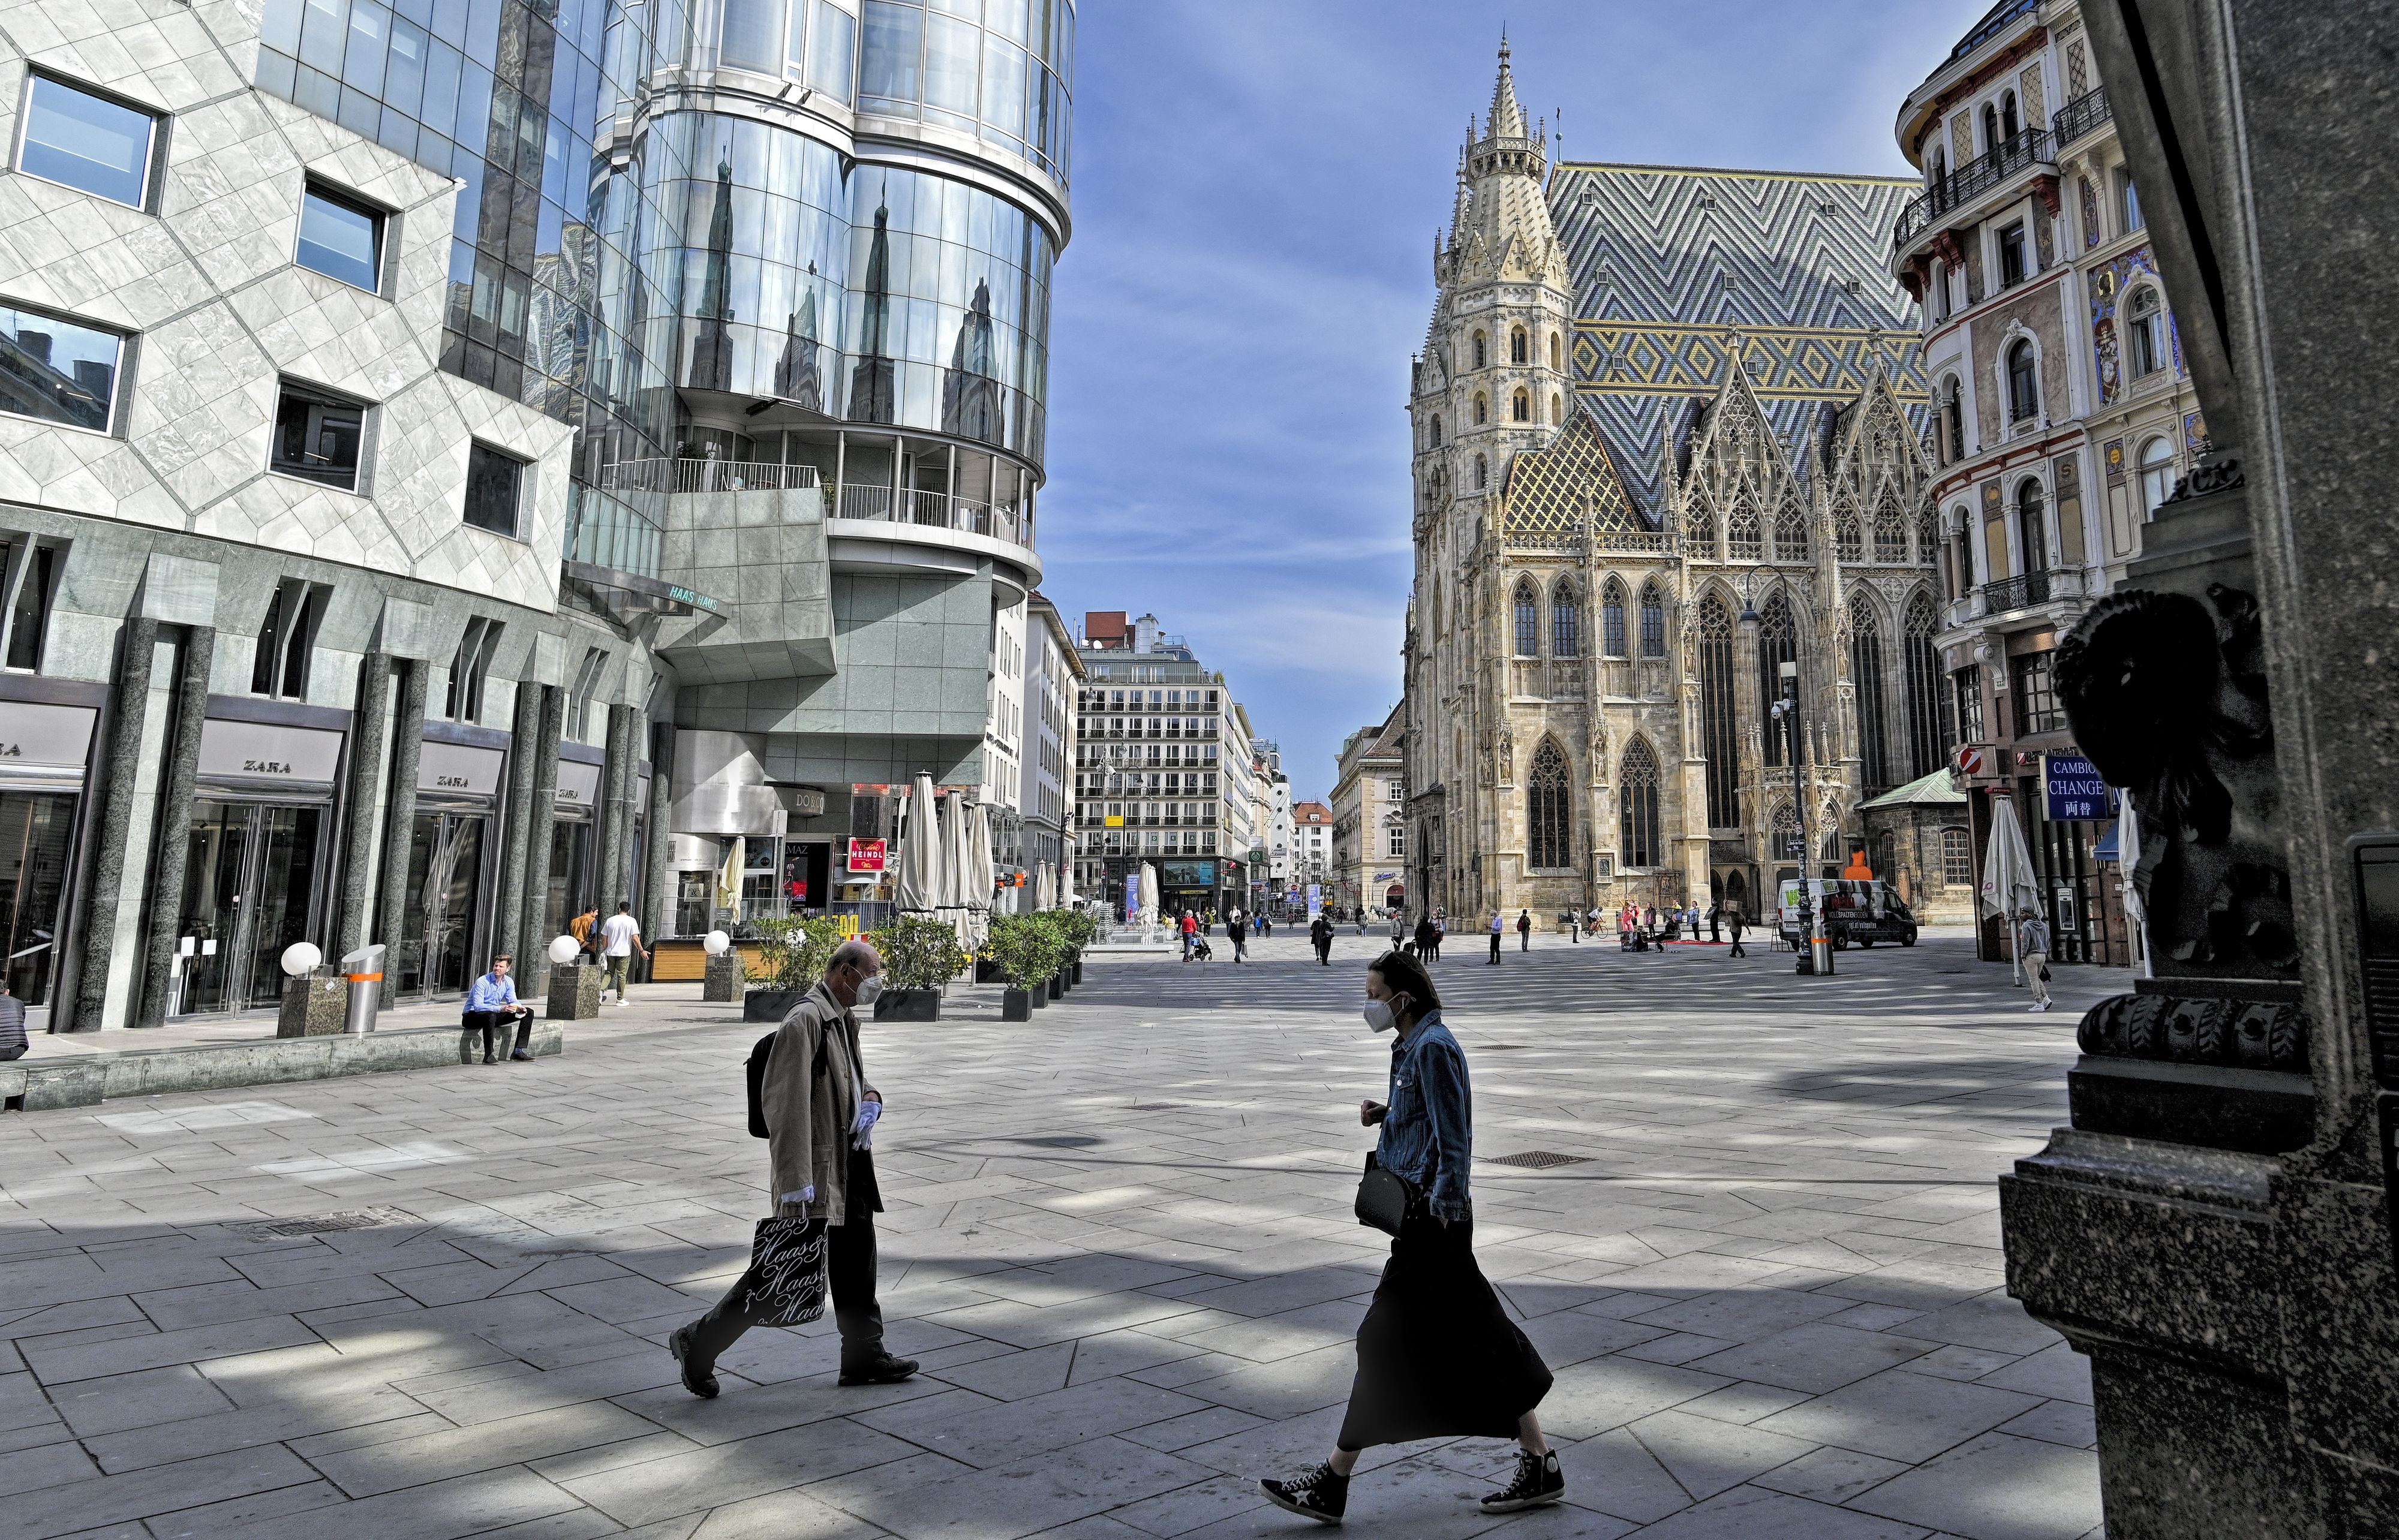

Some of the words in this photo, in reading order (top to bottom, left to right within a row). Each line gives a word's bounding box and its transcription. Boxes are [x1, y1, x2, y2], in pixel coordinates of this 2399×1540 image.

[669, 586, 695, 603] HAAS
[697, 594, 718, 610] HAUS
[243, 760, 291, 774] ZARA
[437, 776, 468, 787] ZARA
[2049, 780, 2104, 795] CHANGE
[558, 789, 578, 799] ZARA
[2065, 801, 2091, 816] 両替
[750, 1229, 808, 1271] Haas
[756, 1257, 819, 1301] Haas
